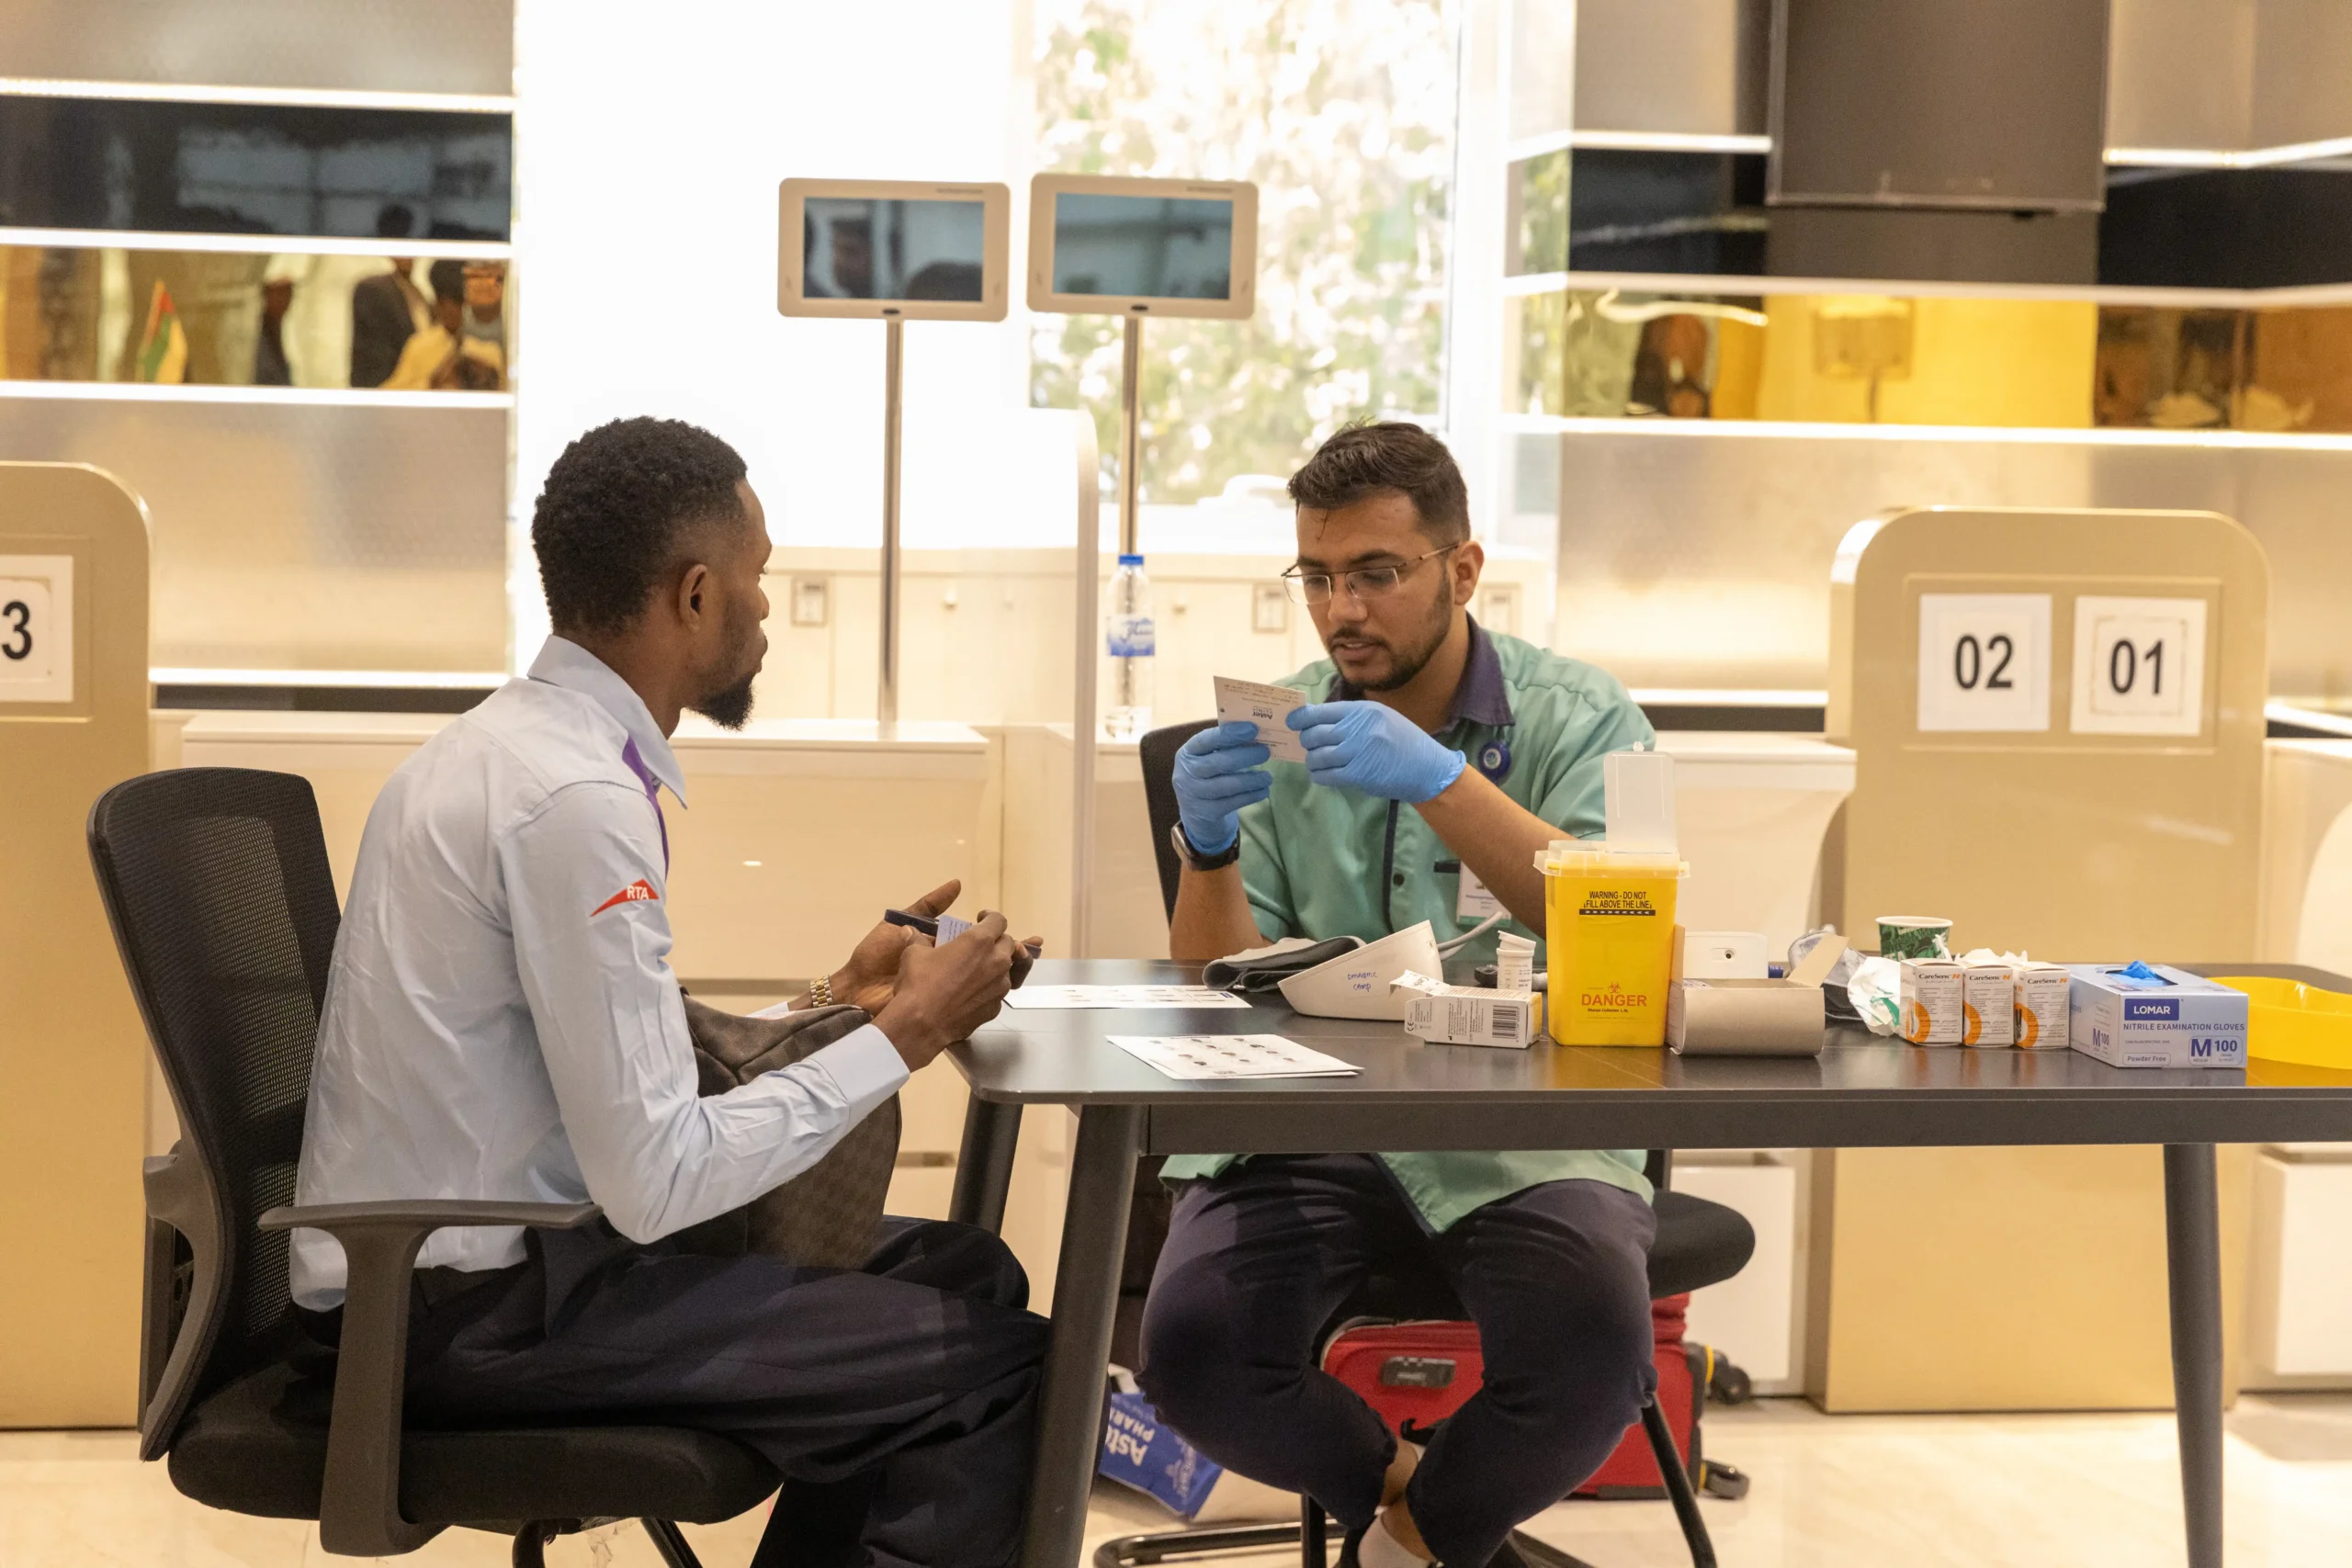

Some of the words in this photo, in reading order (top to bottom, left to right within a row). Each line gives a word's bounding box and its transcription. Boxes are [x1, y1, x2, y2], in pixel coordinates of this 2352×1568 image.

[1954, 634, 2014, 690] 02
[2109, 639, 2165, 695] 01
[1251, 711, 1273, 720] Aster
[627, 885, 650, 900] RTA
[1589, 891, 1618, 899] WARNING
[1622, 900, 1634, 908] THE
[1636, 900, 1649, 908] LINE
[1582, 994, 1647, 1007] DANGER
[2133, 1005, 2171, 1015] LOMAR
[2093, 1028, 2100, 1047] M
[2191, 1039, 2211, 1057] M
[2215, 1040, 2237, 1052] 100
